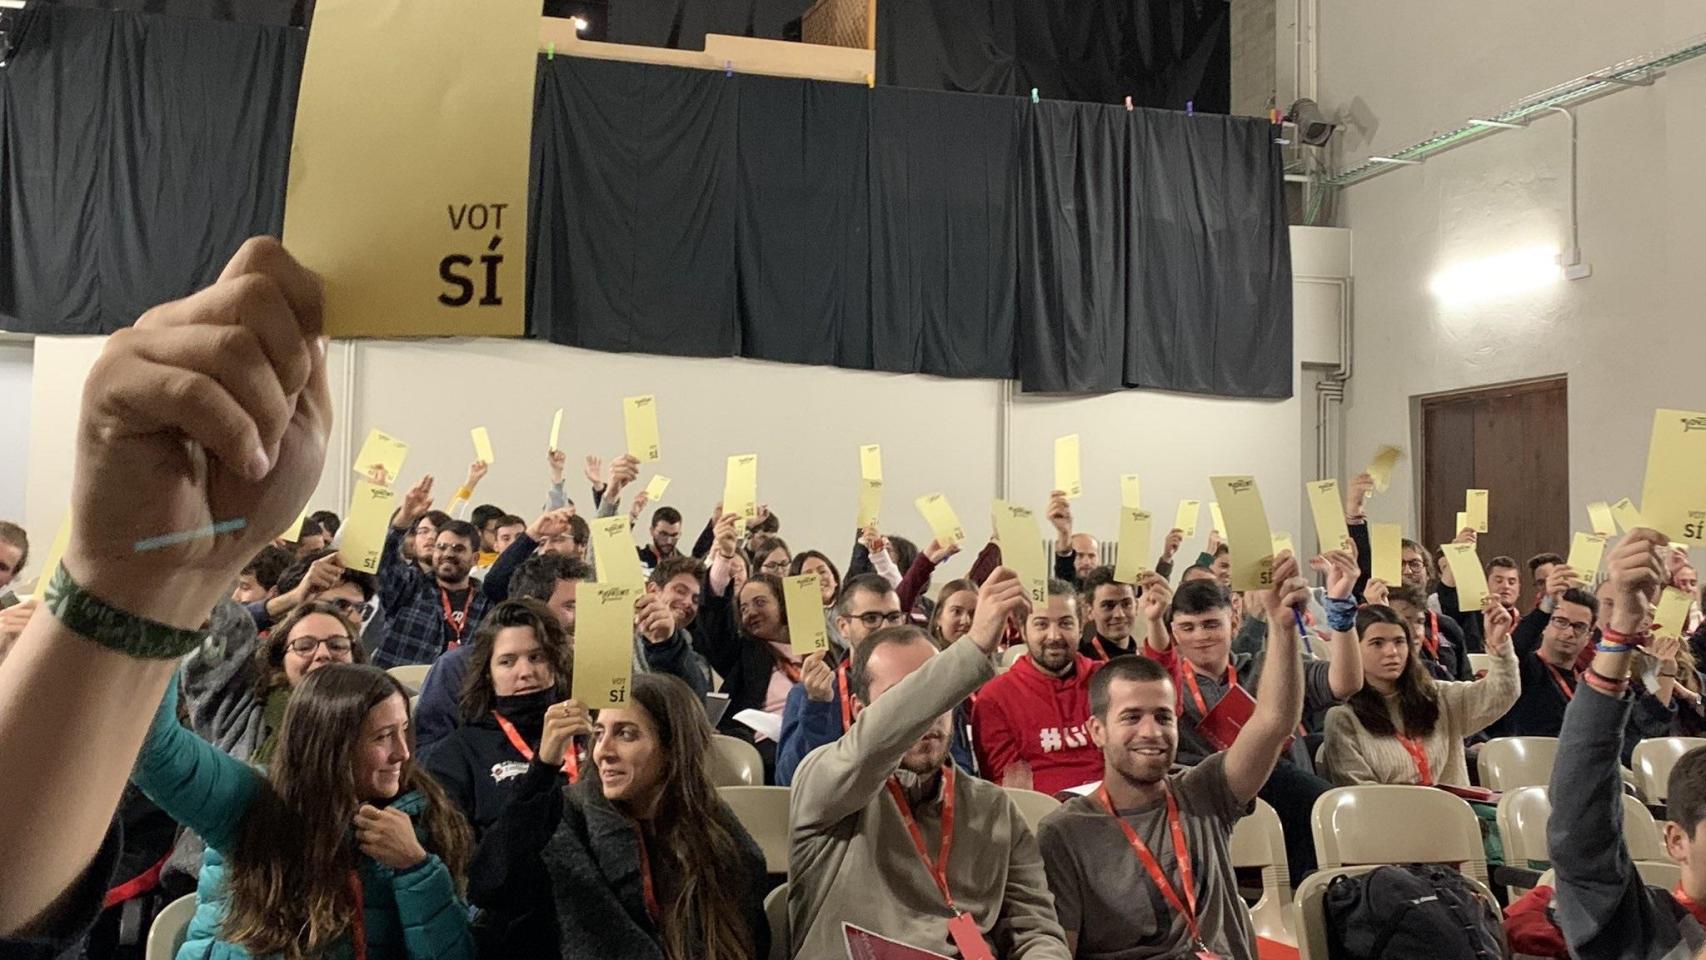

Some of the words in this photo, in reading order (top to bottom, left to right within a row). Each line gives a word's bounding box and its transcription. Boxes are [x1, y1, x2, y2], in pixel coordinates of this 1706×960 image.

[448, 203, 509, 230] VOT
[438, 234, 504, 306] SÍ
[1683, 520, 1705, 540] SÍ
[363, 556, 378, 569] SÍ
[1032, 587, 1044, 602] SÍ
[612, 677, 626, 685] VOT
[608, 685, 626, 703] SÍ
